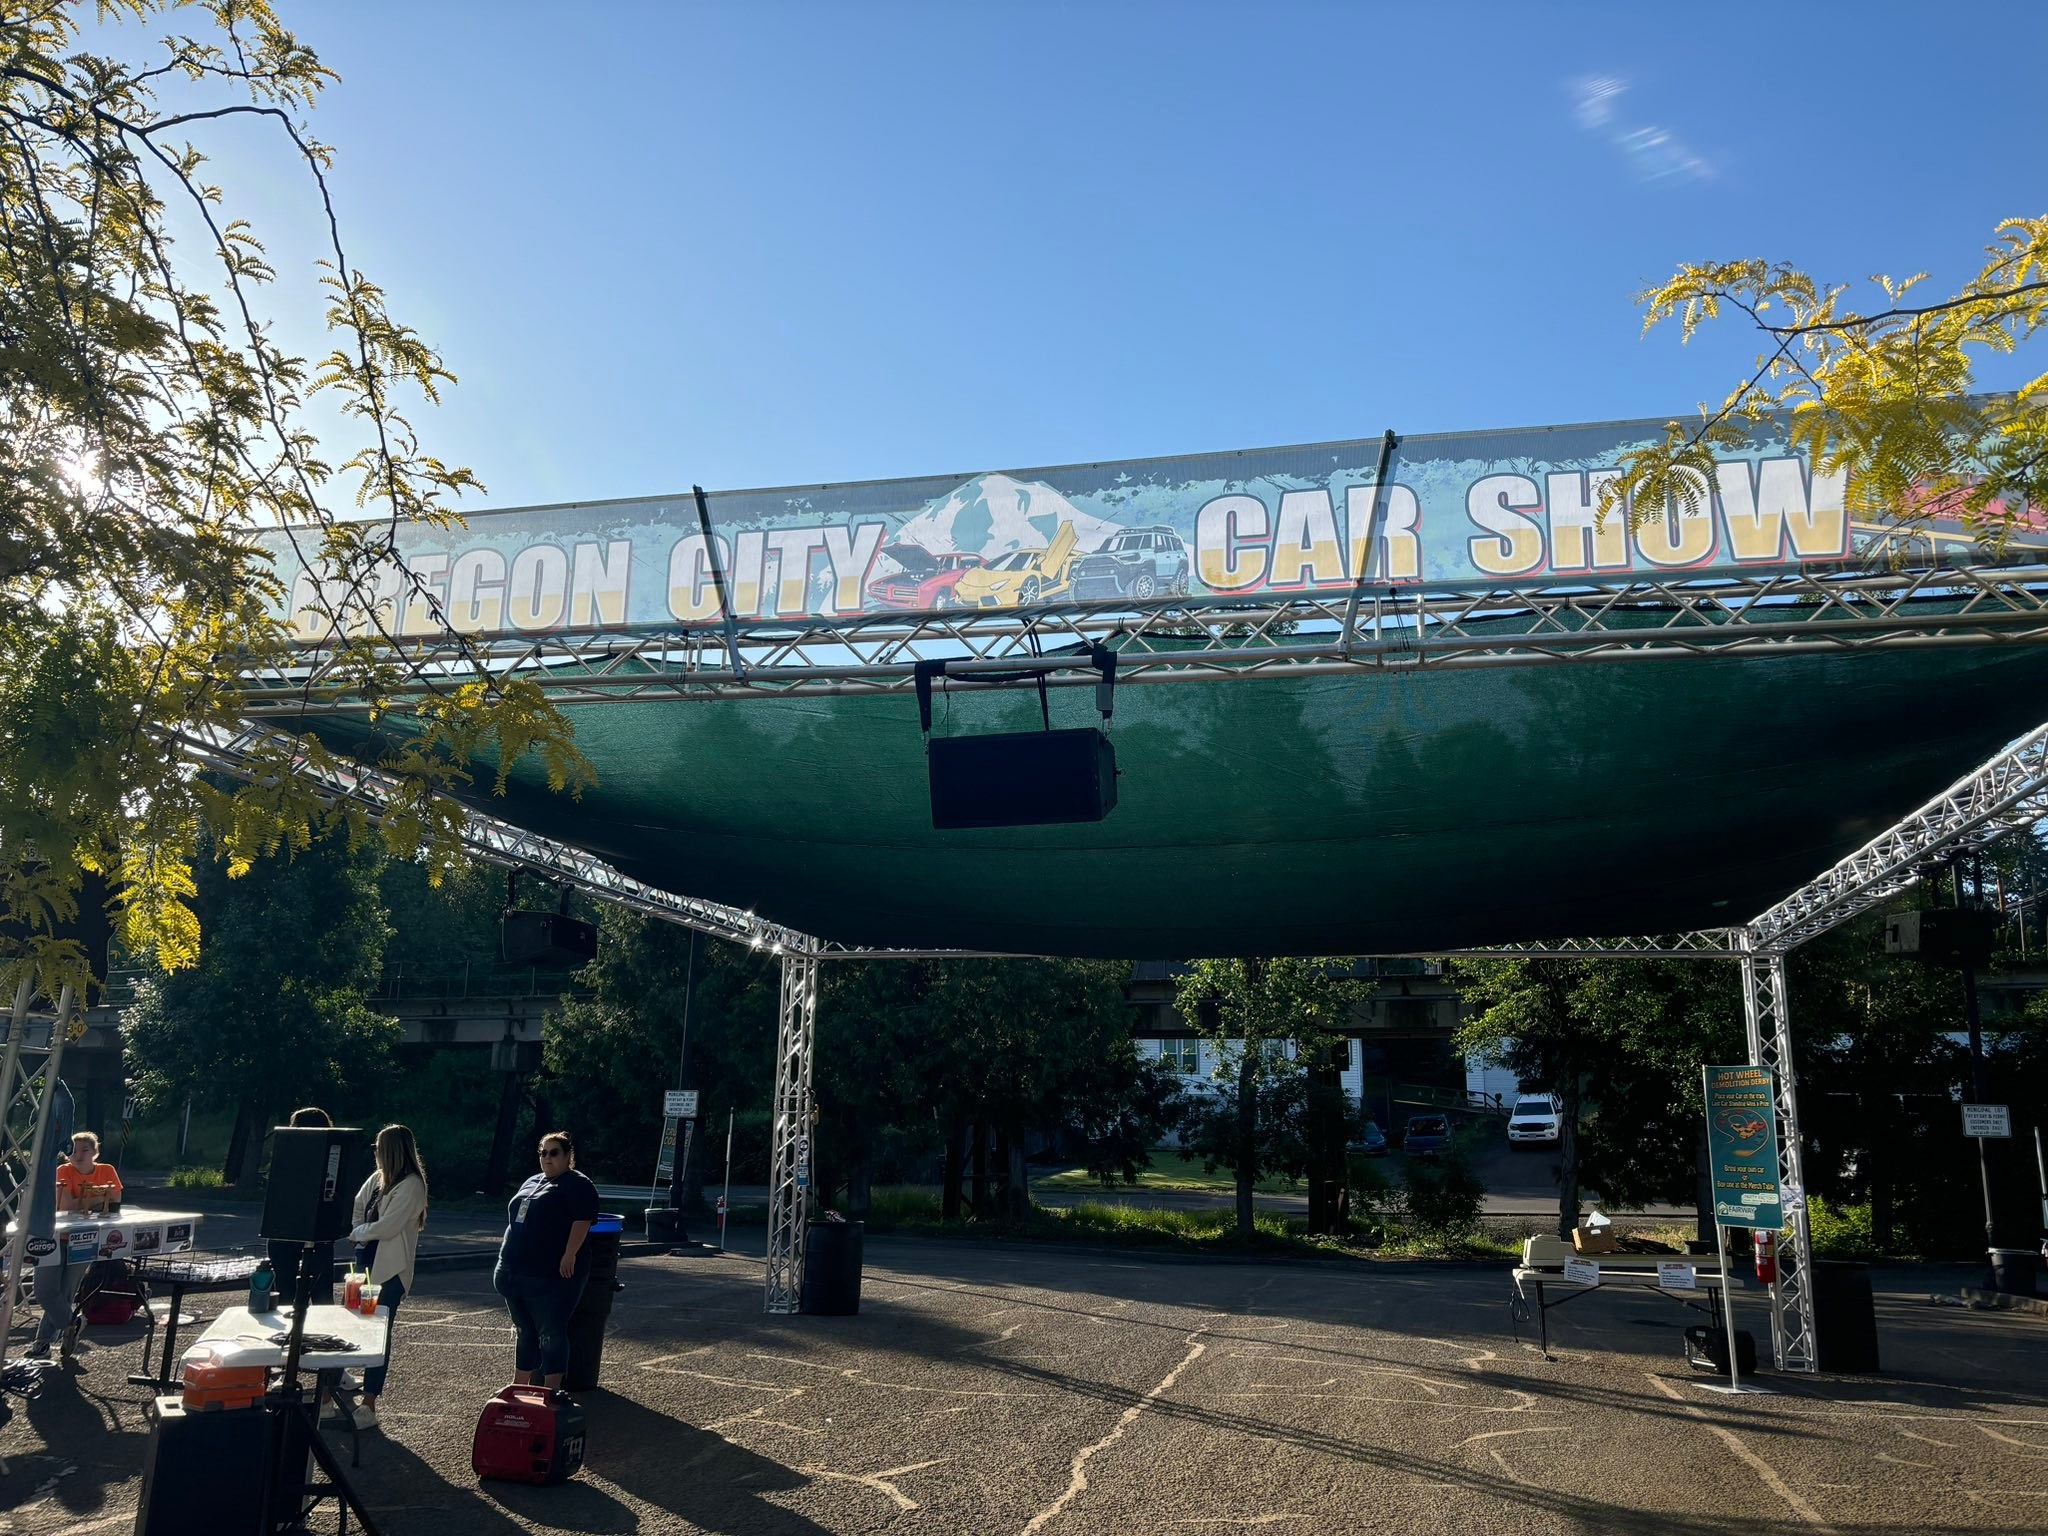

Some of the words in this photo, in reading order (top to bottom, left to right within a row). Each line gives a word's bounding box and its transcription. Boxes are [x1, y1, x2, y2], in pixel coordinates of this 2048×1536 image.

[290, 537, 634, 645] OREGON
[667, 519, 887, 624] CITY
[1194, 483, 1422, 594] CAR
[1466, 455, 1852, 580] SHOW
[1718, 1071, 1735, 1080] HOT
[27, 1240, 56, 1252] Garage
